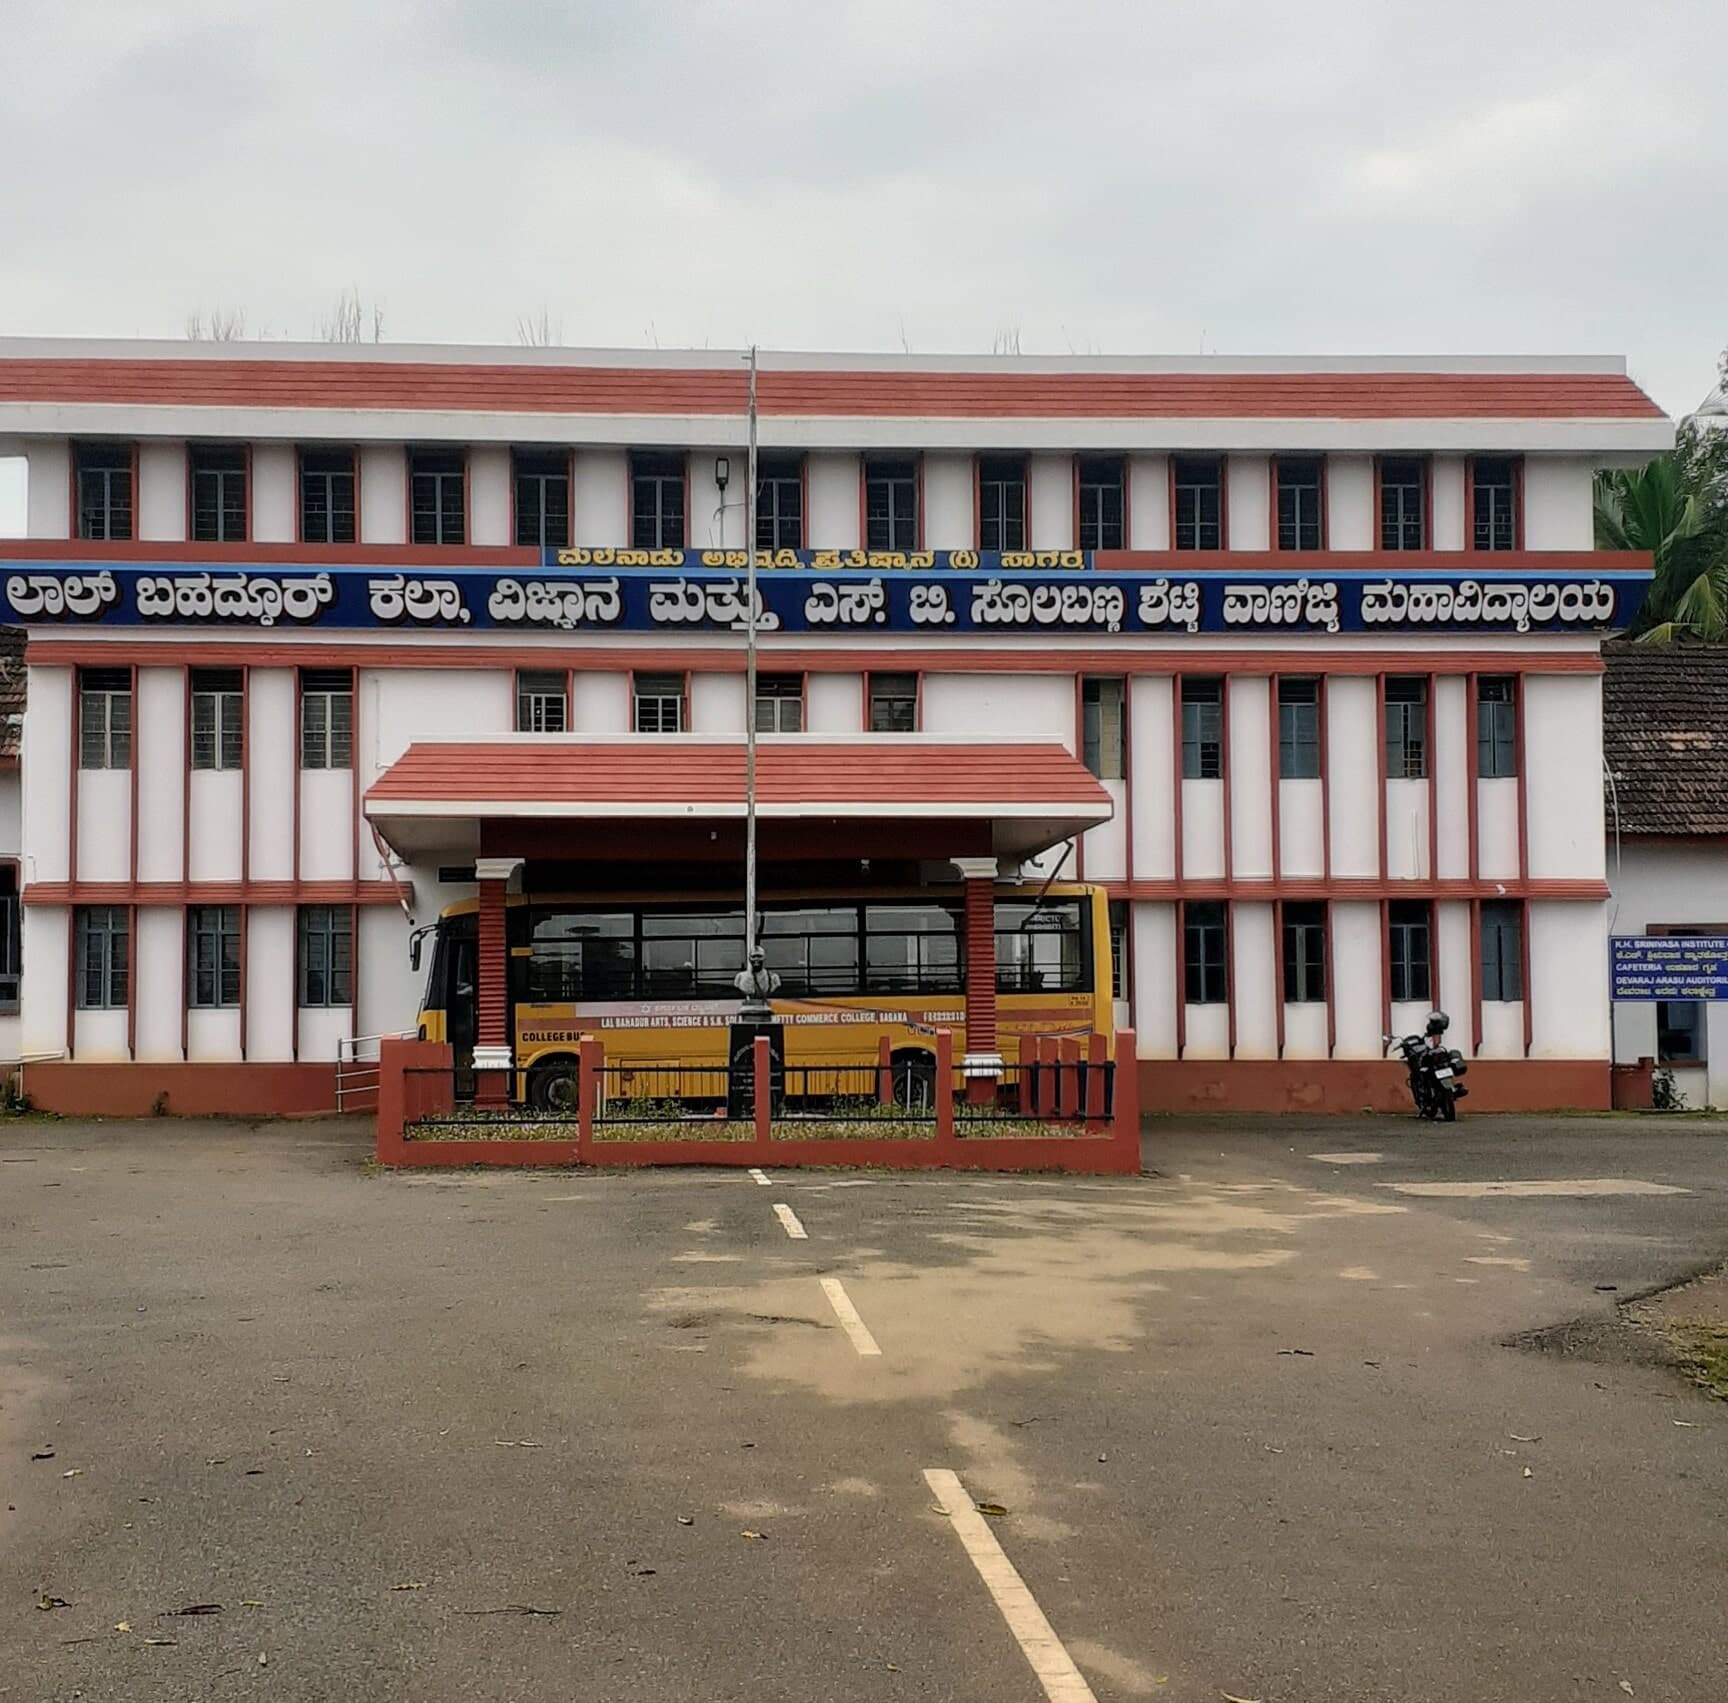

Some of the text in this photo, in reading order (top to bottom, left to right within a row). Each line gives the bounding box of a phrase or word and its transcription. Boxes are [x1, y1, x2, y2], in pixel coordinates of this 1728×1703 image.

[558, 549, 684, 566] ಮಲೆನಾಡು
[7, 570, 117, 615] ಲಾಲ್
[136, 572, 333, 626] ಬಹದ್ದೂರ್
[369, 574, 470, 623] ಕಲಾ,
[488, 576, 620, 629] ವಿಜ್ಞಾನ
[650, 577, 779, 630] ಮತ್ತು
[805, 578, 886, 623] ಎಸ್.
[909, 585, 955, 623] ಬಿ.
[1138, 579, 1199, 632] ಶೆಟ್ಟಿ
[1223, 579, 1340, 632] ವಾಣಿಜ್ಯ
[1361, 579, 1614, 632] ಮಹಾವಿದ್ಯಾಲಯ
[672, 1014, 702, 1027] SCIENCE
[796, 1013, 838, 1024] COMMERCE
[522, 1032, 565, 1042] COLLEGE
